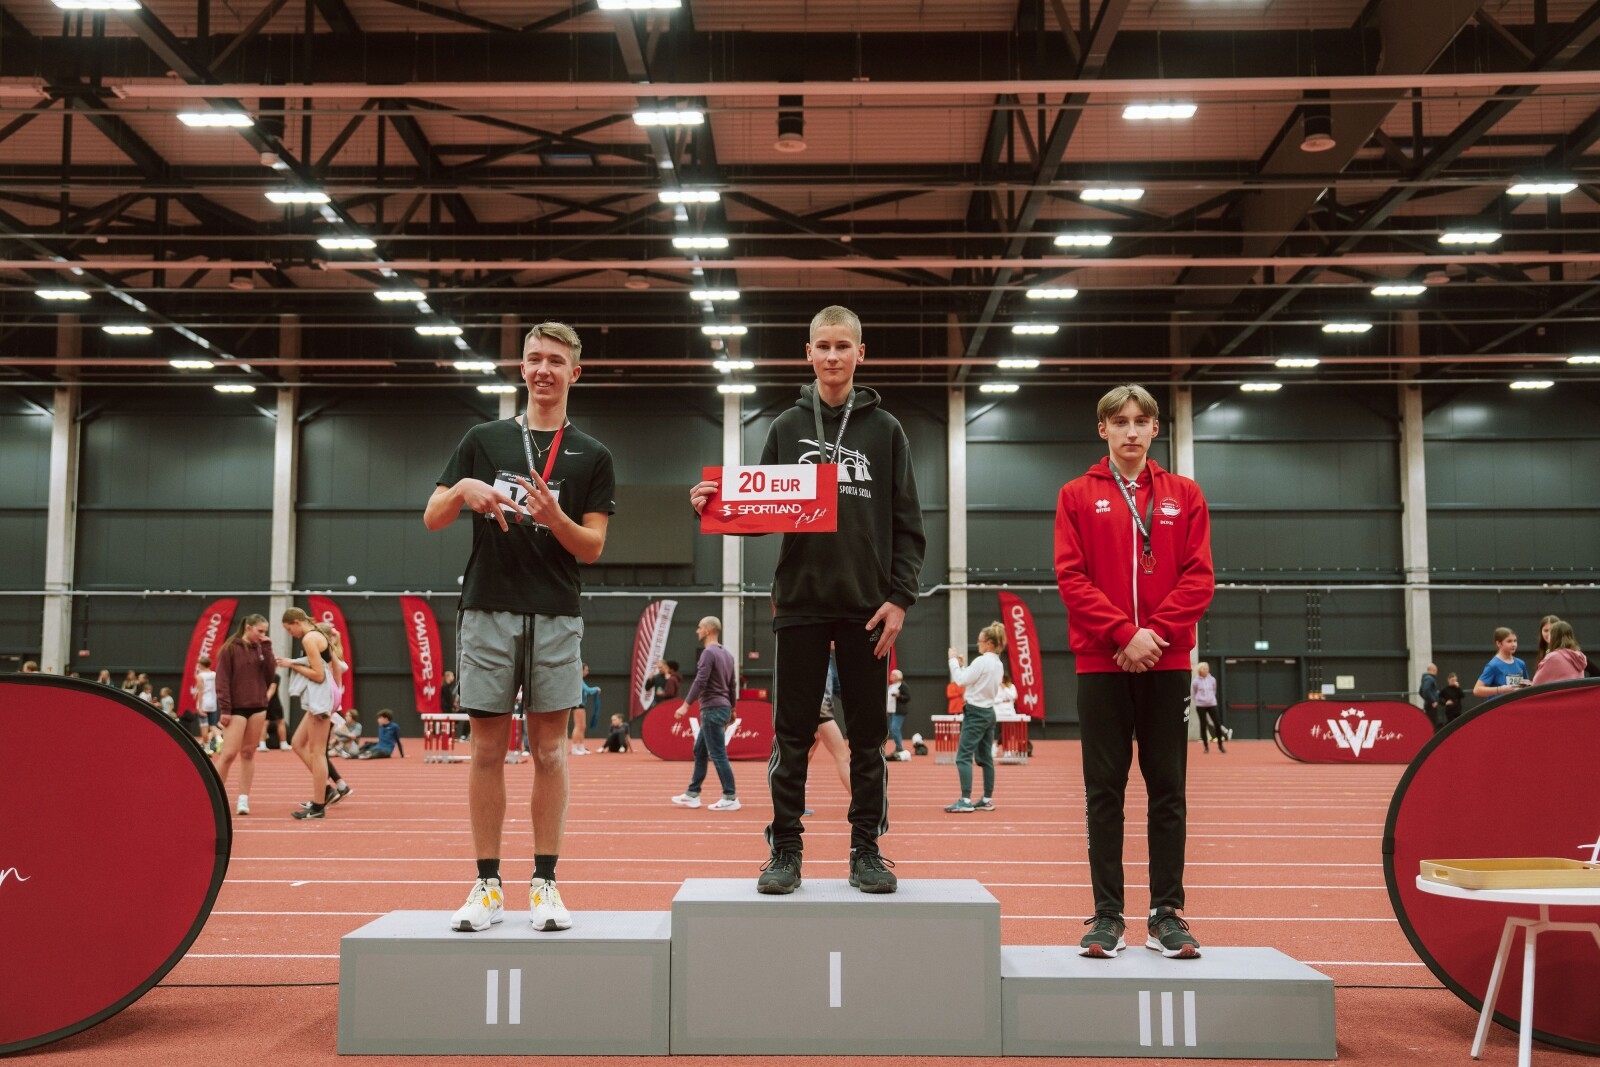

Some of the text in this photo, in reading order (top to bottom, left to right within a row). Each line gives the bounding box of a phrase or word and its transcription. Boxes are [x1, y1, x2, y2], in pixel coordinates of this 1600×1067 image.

[738, 471, 800, 493] 20 EUR
[839, 485, 858, 496] SPORTA
[737, 504, 802, 515] SPORTLAND
[485, 968, 522, 1025] II
[829, 951, 842, 1008] I
[1138, 990, 1197, 1047] III
